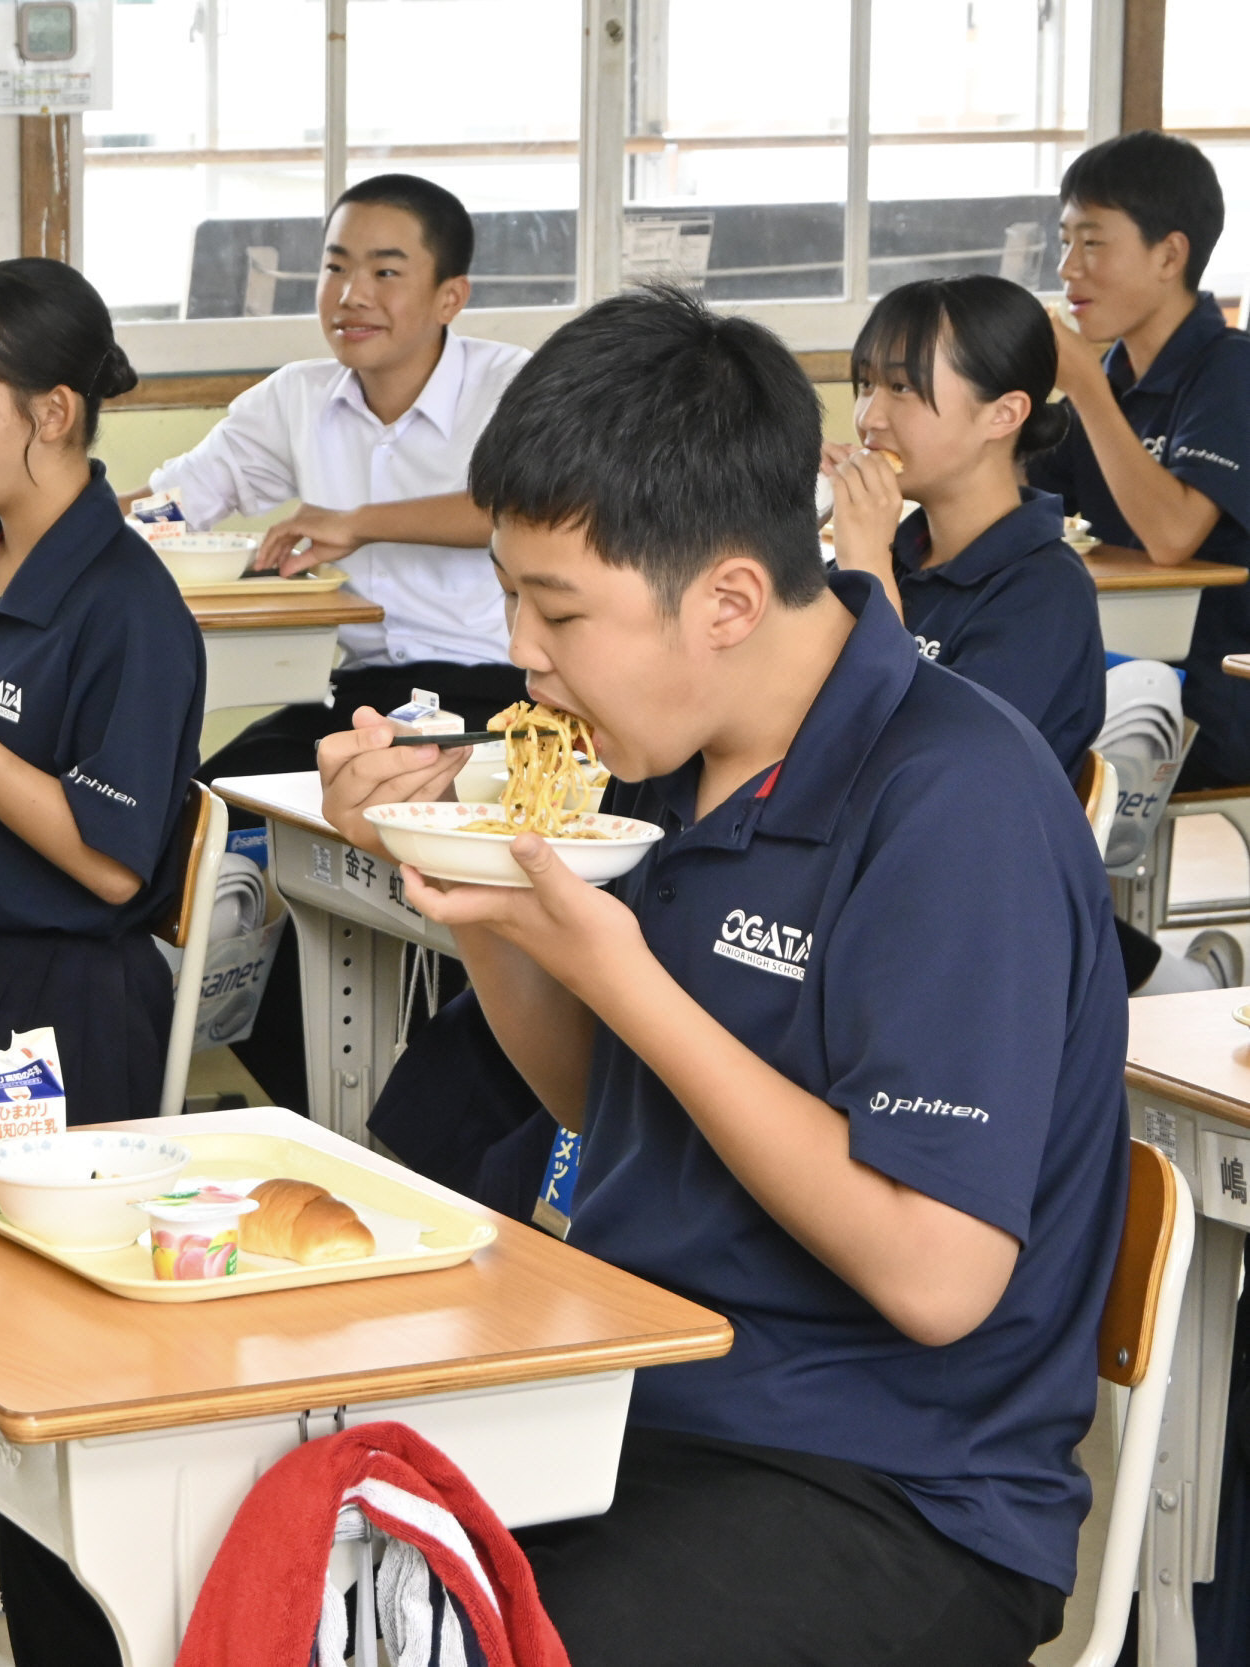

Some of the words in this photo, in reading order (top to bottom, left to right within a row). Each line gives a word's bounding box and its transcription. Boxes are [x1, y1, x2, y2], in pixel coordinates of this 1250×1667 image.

[74, 772, 137, 808] phiten
[345, 847, 377, 888] 金子
[722, 909, 813, 963] OGATA
[717, 943, 745, 959] JUNIOR
[746, 954, 770, 969] HIGH
[772, 961, 806, 979] SCHOO
[891, 1096, 991, 1124] phiten
